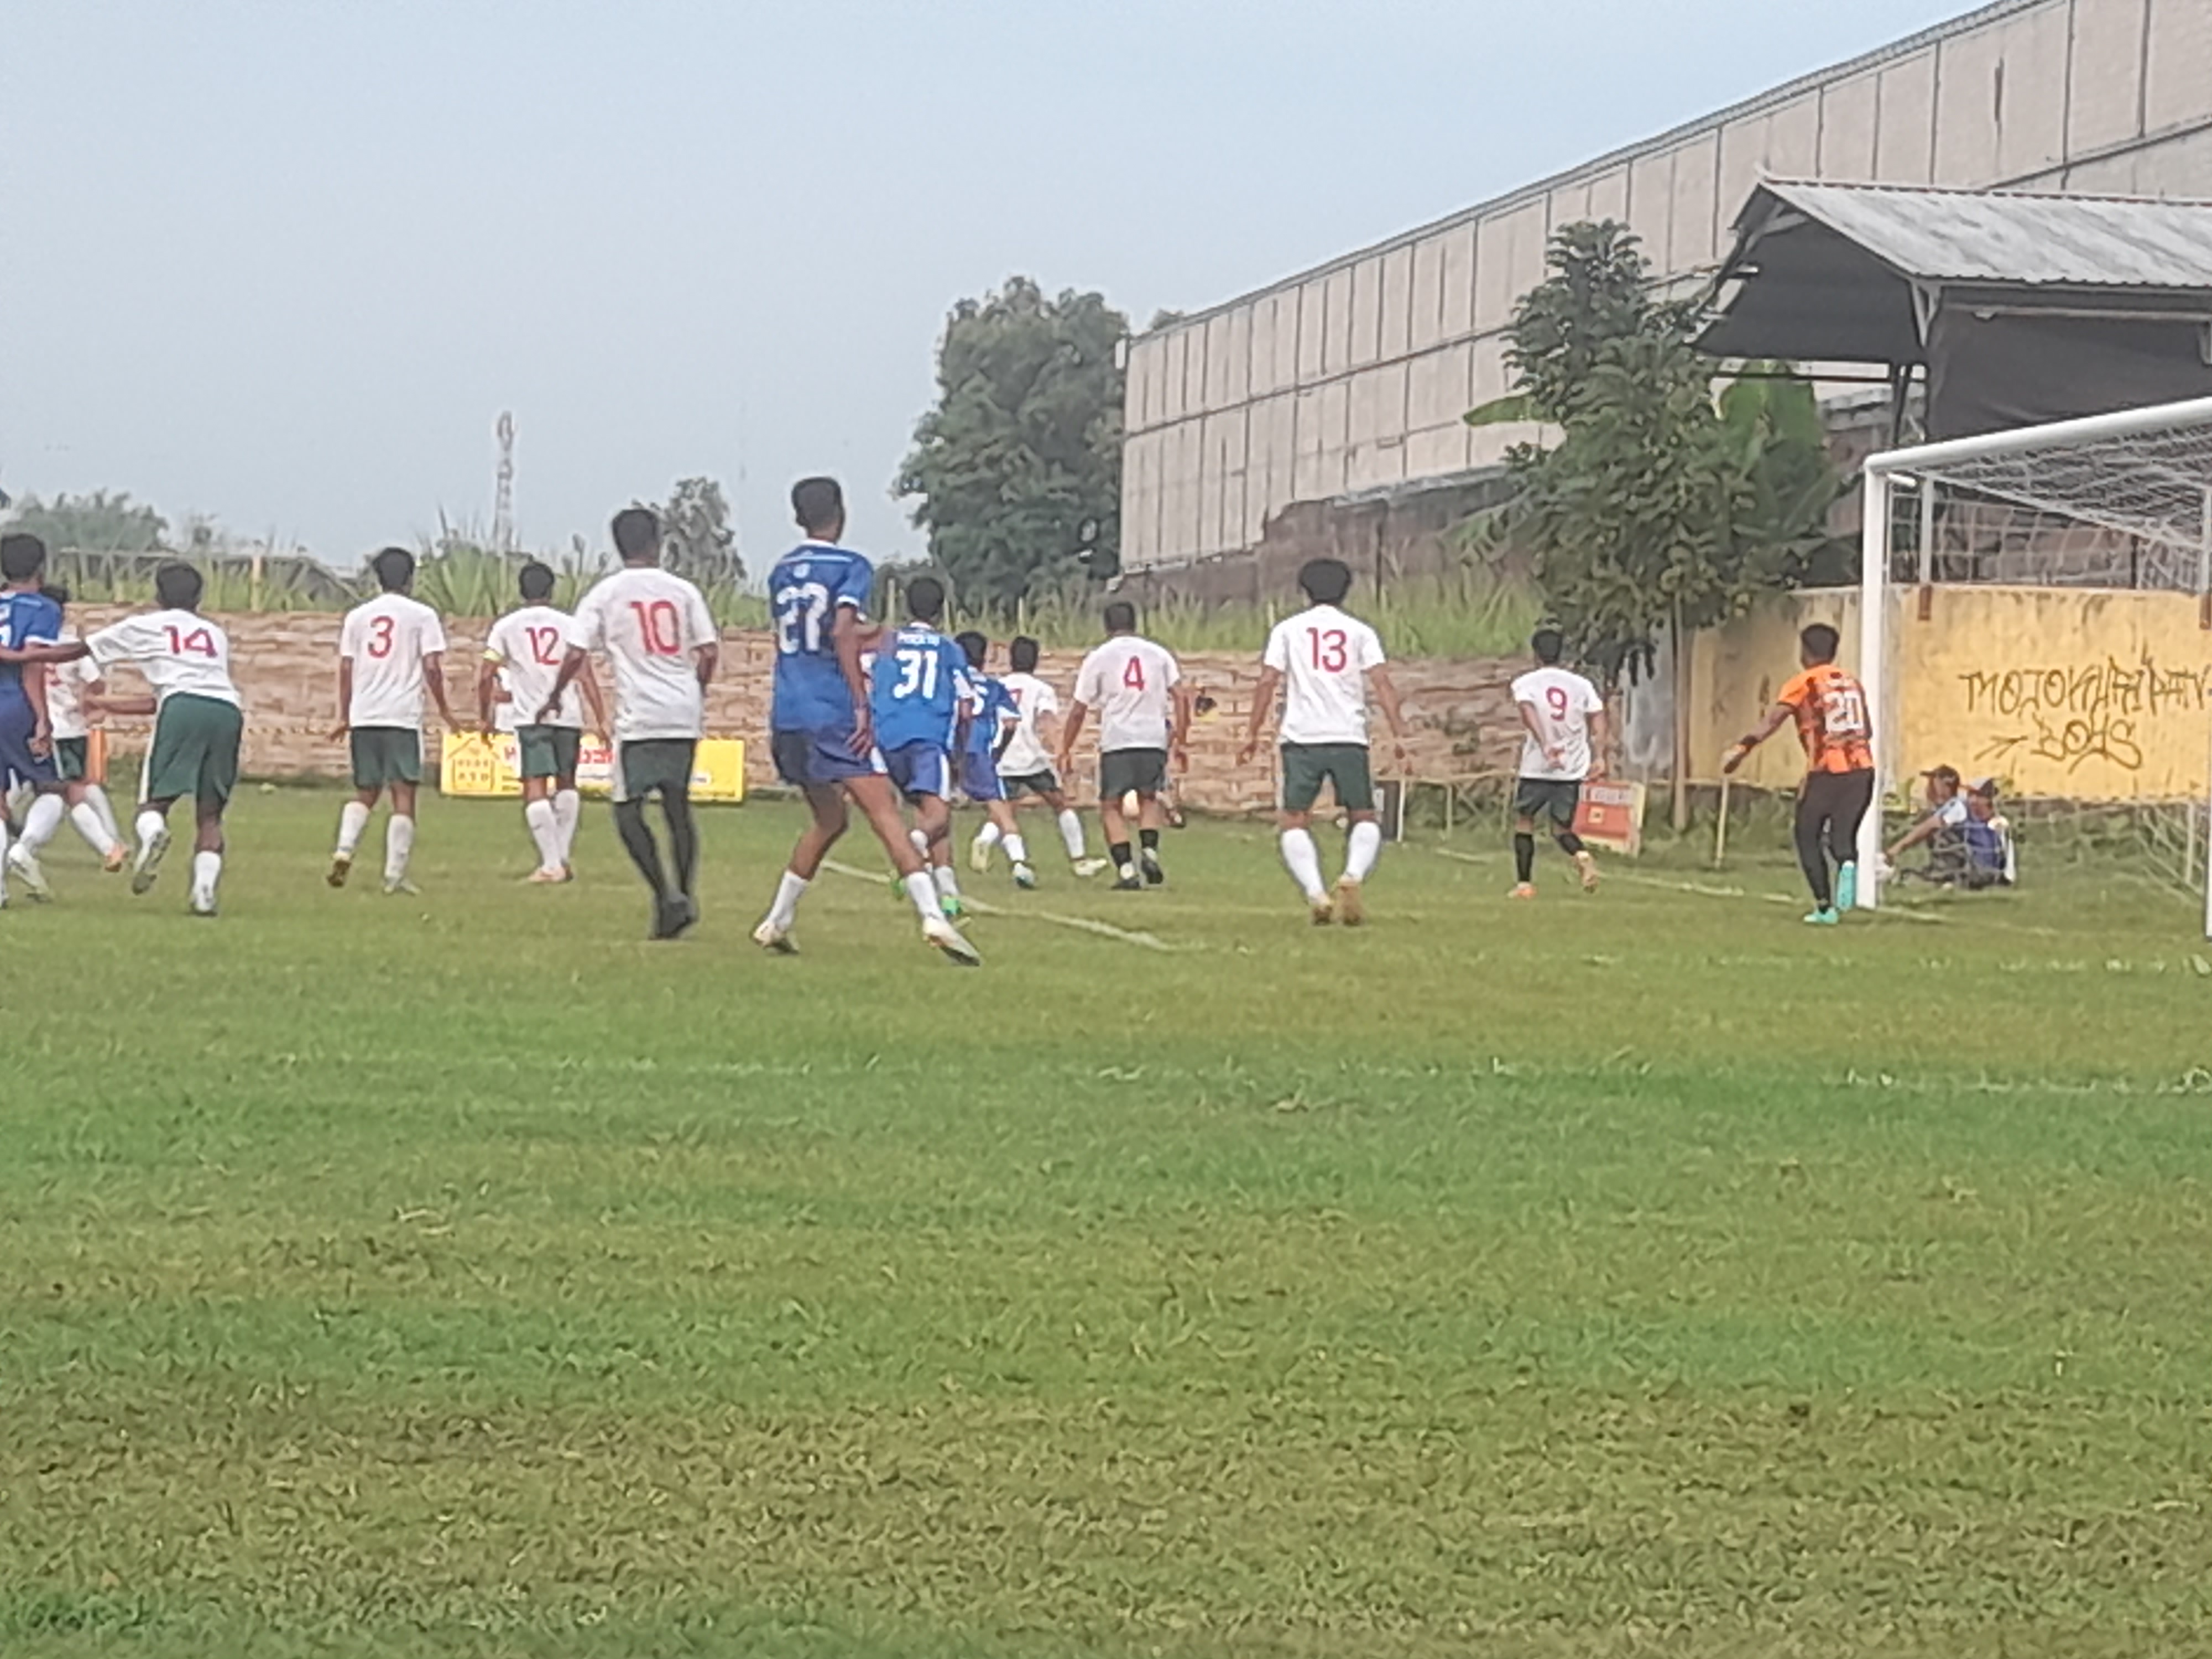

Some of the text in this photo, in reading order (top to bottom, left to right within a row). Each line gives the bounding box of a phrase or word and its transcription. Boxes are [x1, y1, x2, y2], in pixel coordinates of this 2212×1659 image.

[367, 615, 395, 659] 3
[629, 599, 681, 655] 10
[776, 582, 830, 654] 27
[161, 624, 218, 658] 14
[525, 626, 560, 665] 12
[1306, 627, 1347, 672] 13
[893, 649, 938, 699] 31
[1123, 655, 1145, 691] 4
[1546, 687, 1567, 720] 9
